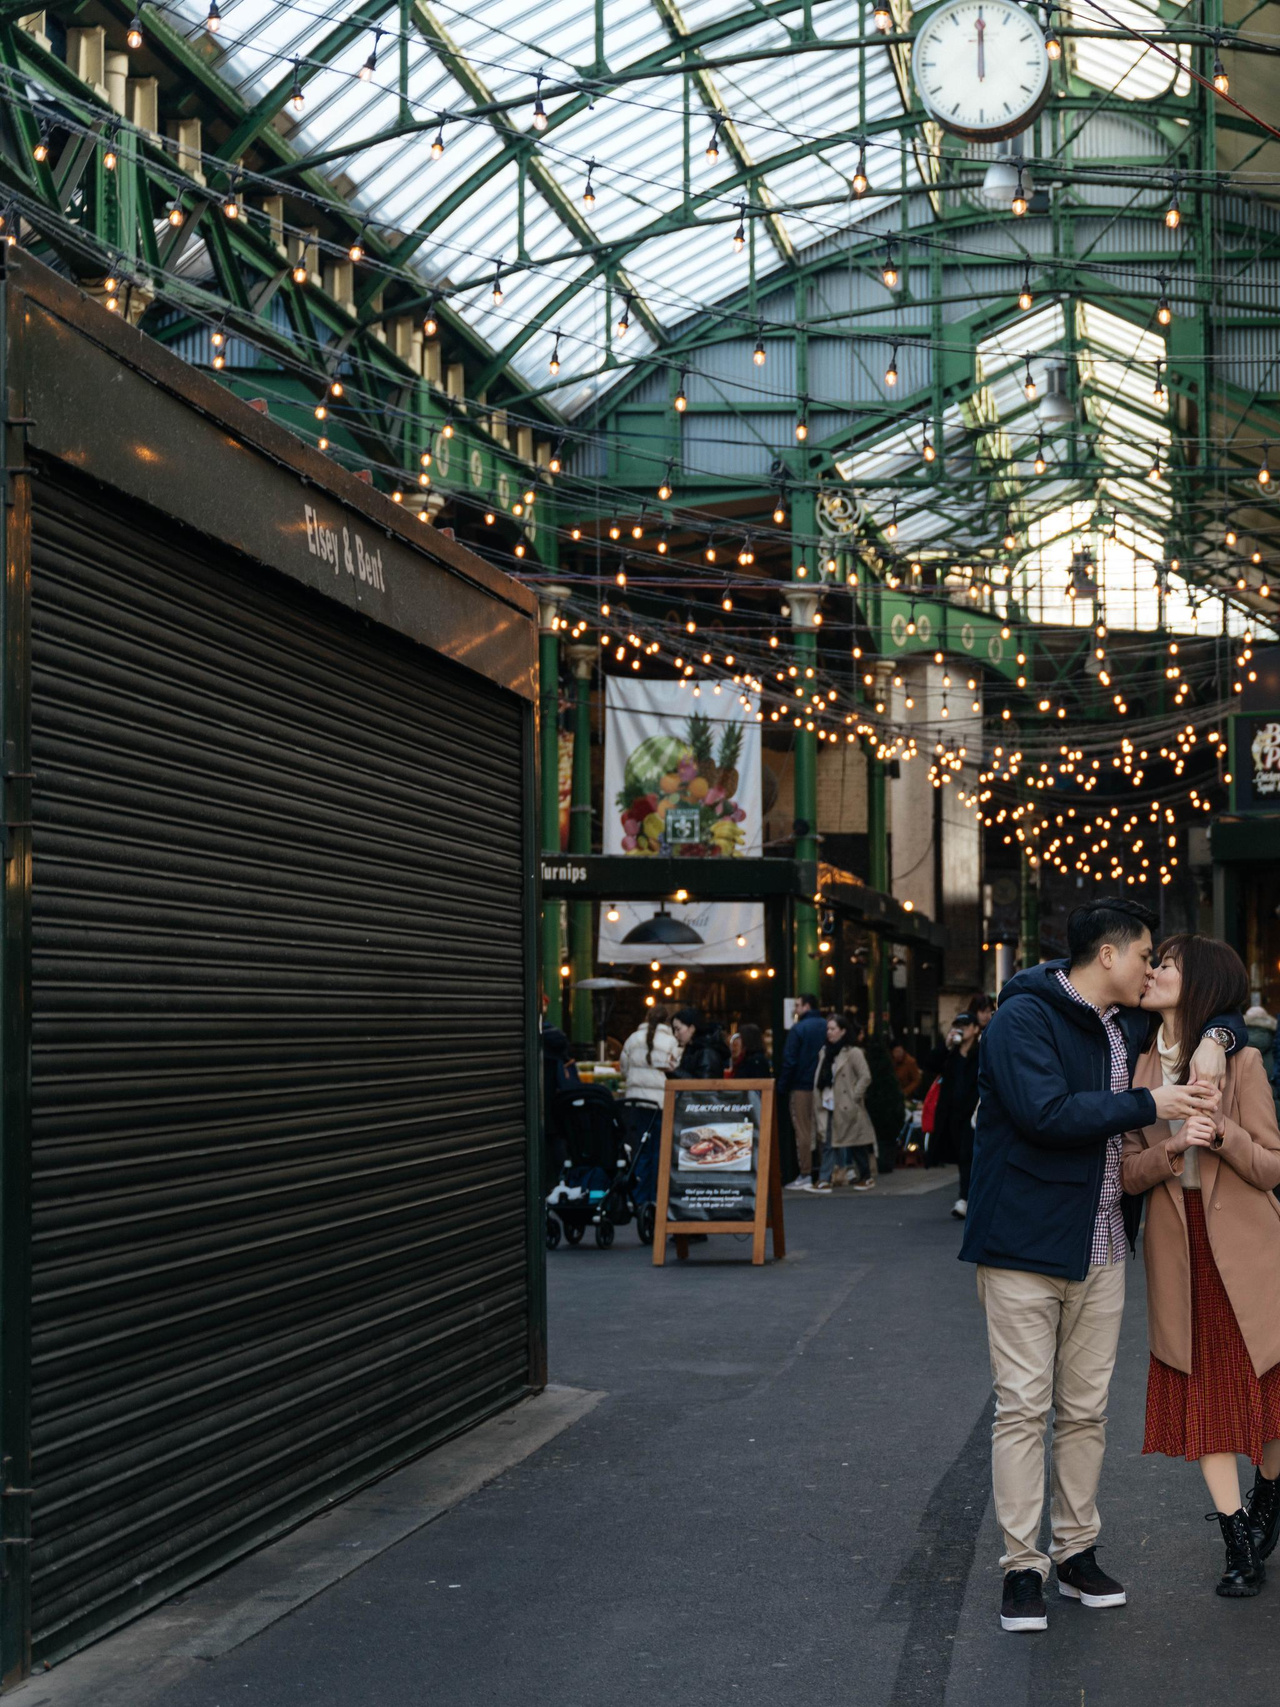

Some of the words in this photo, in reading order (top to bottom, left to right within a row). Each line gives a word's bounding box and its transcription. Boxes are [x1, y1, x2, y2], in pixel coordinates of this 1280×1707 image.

[304, 504, 339, 575] Elsey
[342, 526, 355, 576] &
[355, 534, 385, 593] Bent
[541, 862, 587, 884] Turnips
